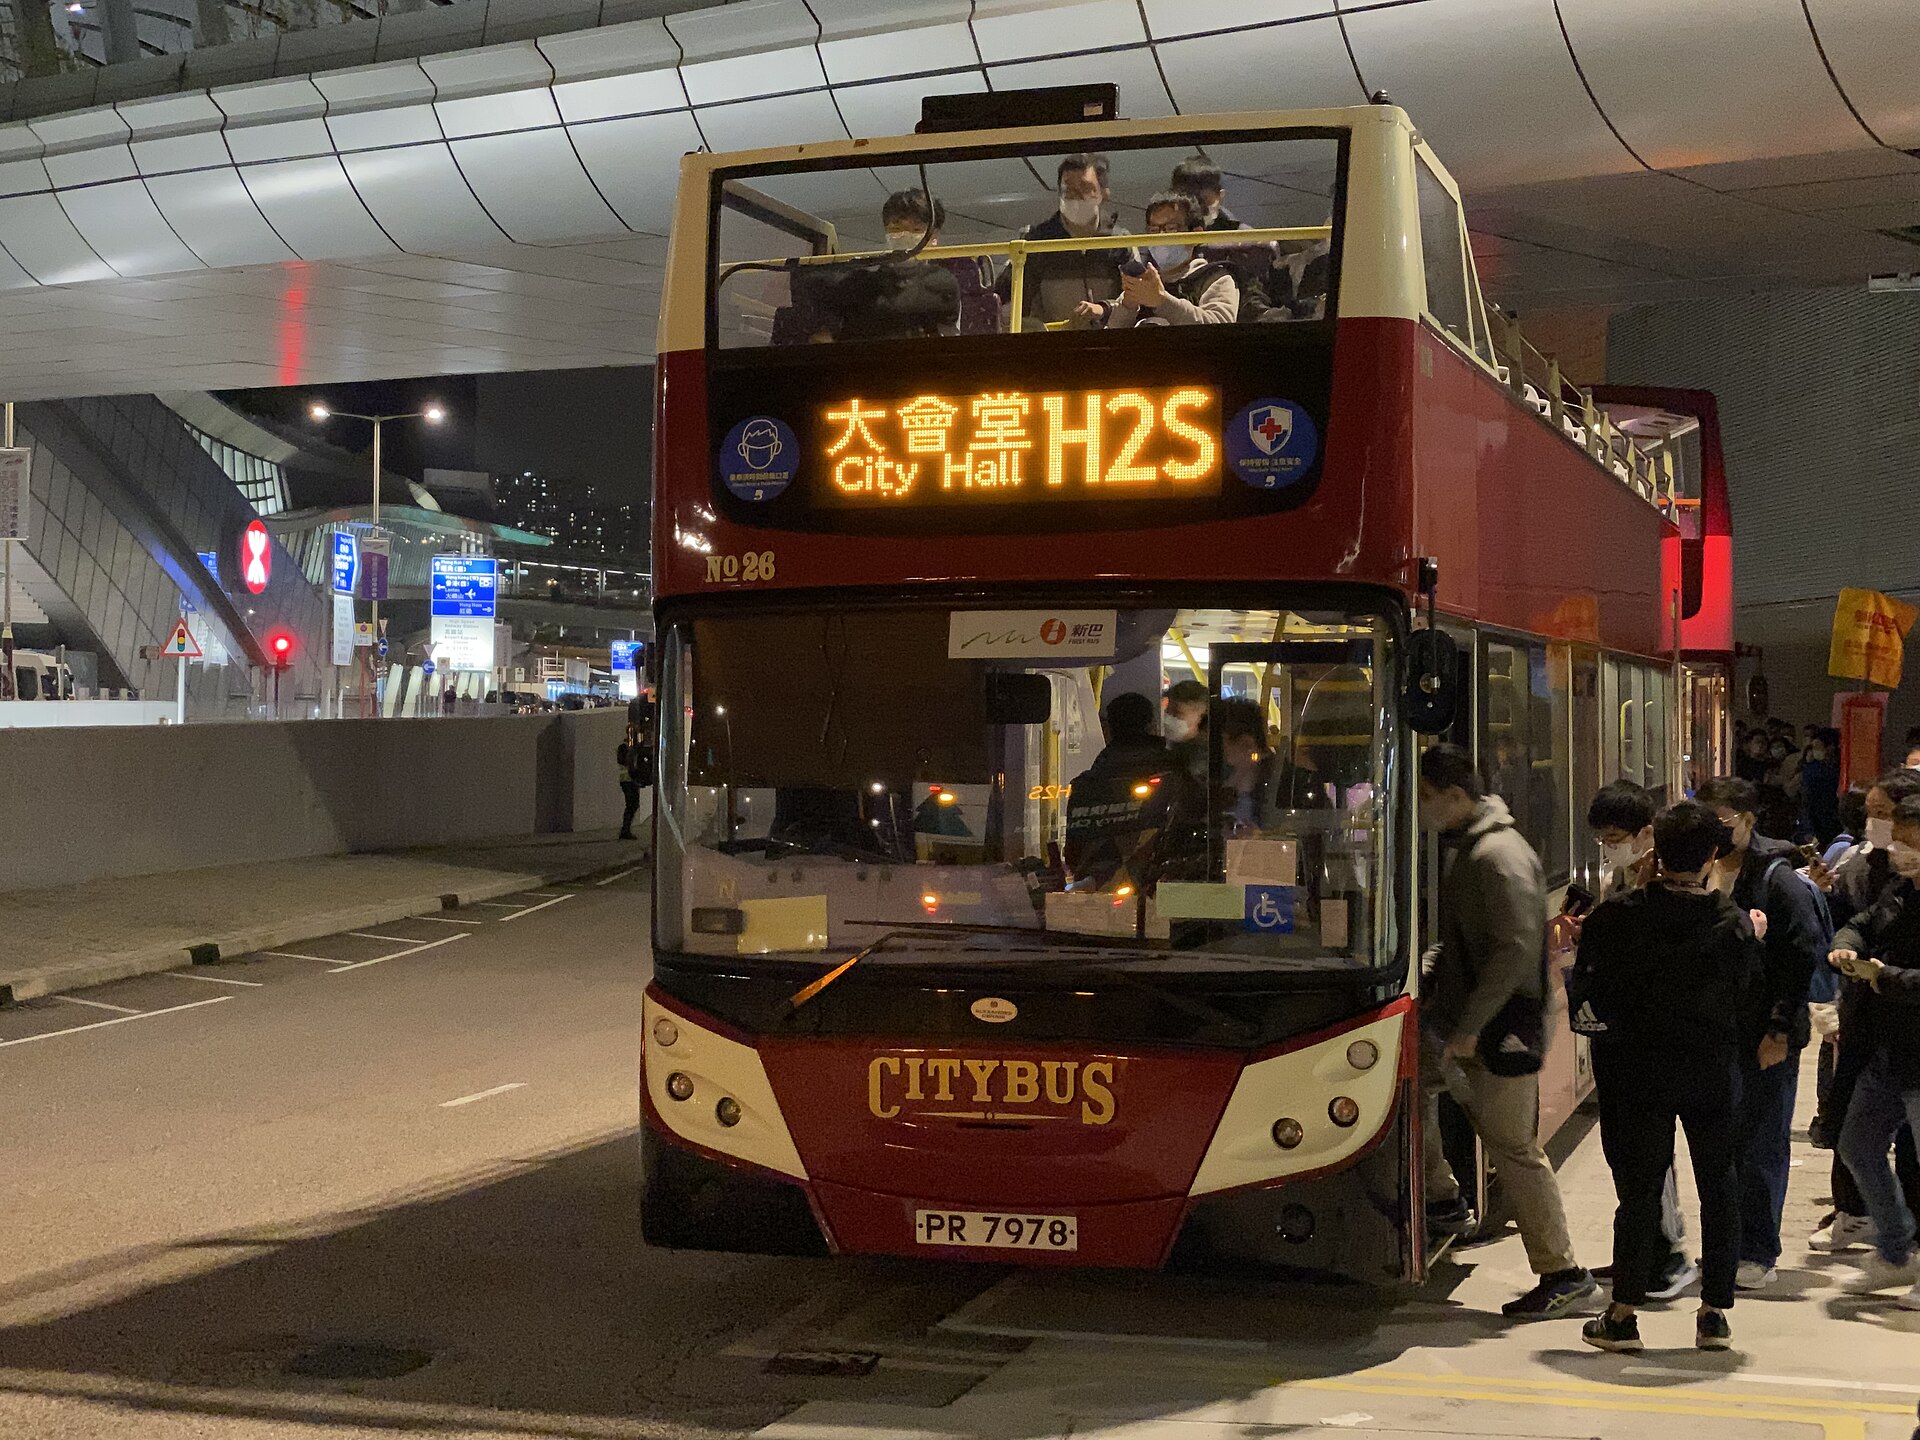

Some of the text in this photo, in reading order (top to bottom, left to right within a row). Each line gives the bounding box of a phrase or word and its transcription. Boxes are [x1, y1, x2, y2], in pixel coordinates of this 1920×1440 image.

[825, 392, 1033, 457] 大會堂
[1042, 390, 1216, 485] H2S
[834, 449, 1022, 497] City Hall
[742, 550, 776, 582] 26
[1070, 623, 1104, 637] 新巴
[868, 1057, 1115, 1125] CITYBUS
[925, 1213, 1069, 1247] PR 7978
